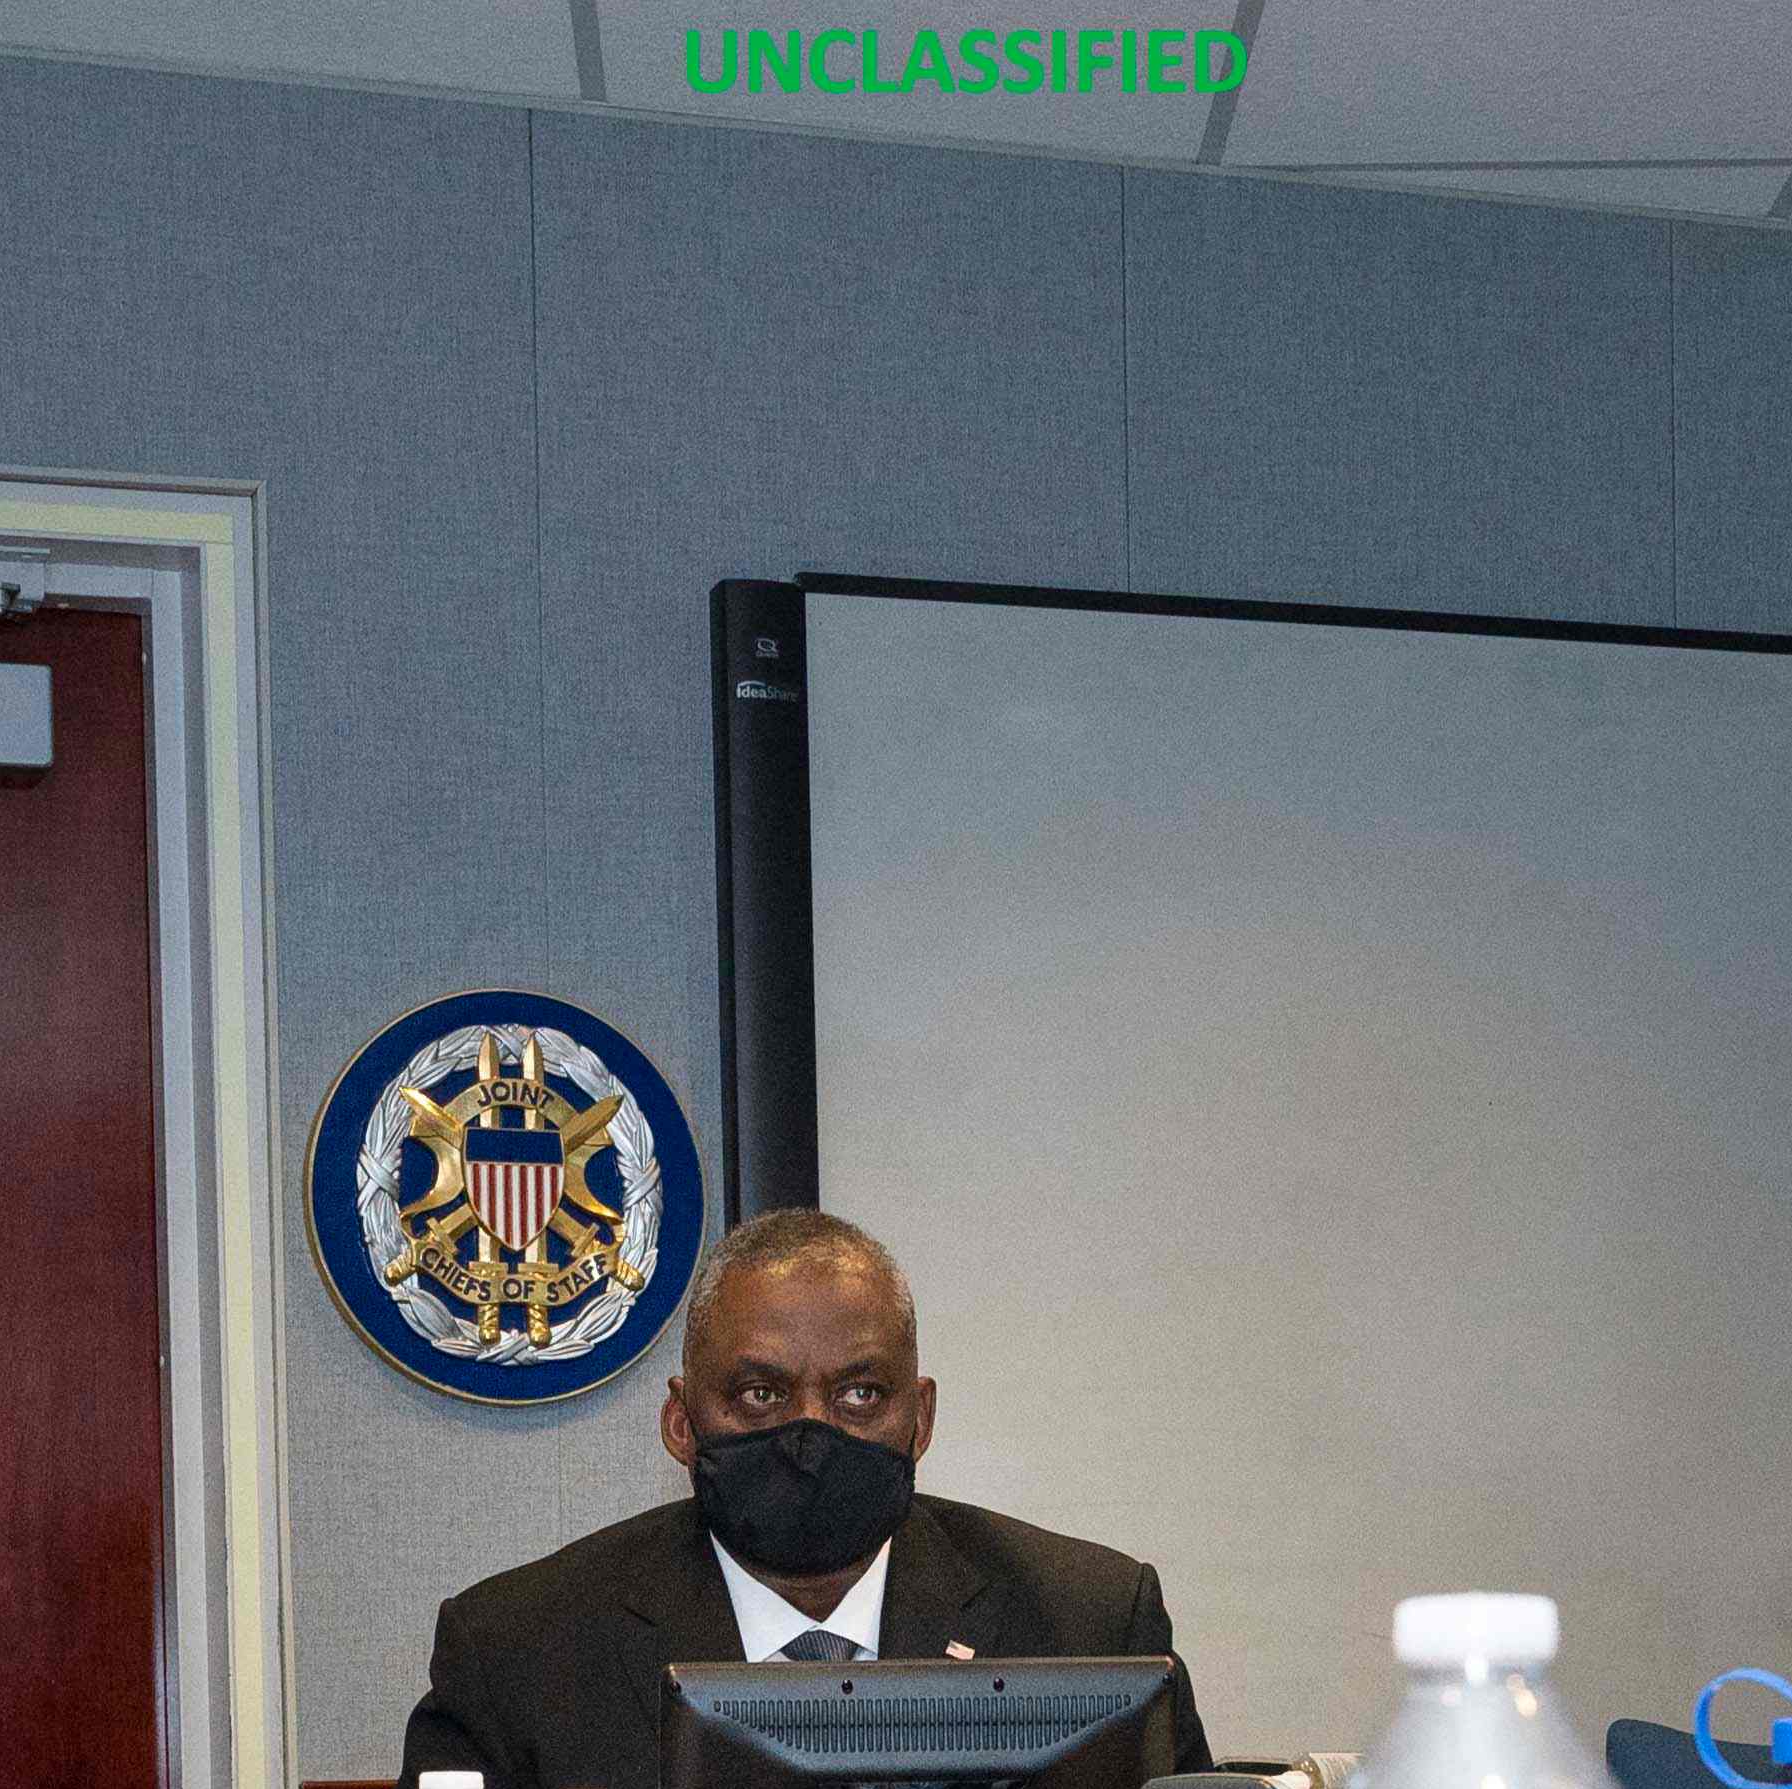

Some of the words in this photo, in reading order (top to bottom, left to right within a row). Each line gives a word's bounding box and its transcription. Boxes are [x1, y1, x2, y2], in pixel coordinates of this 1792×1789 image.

[477, 1081, 555, 1108] JOINT
[421, 1248, 491, 1301] CHIEFS
[503, 1278, 535, 1299] OF
[547, 1253, 607, 1302] STAFF
